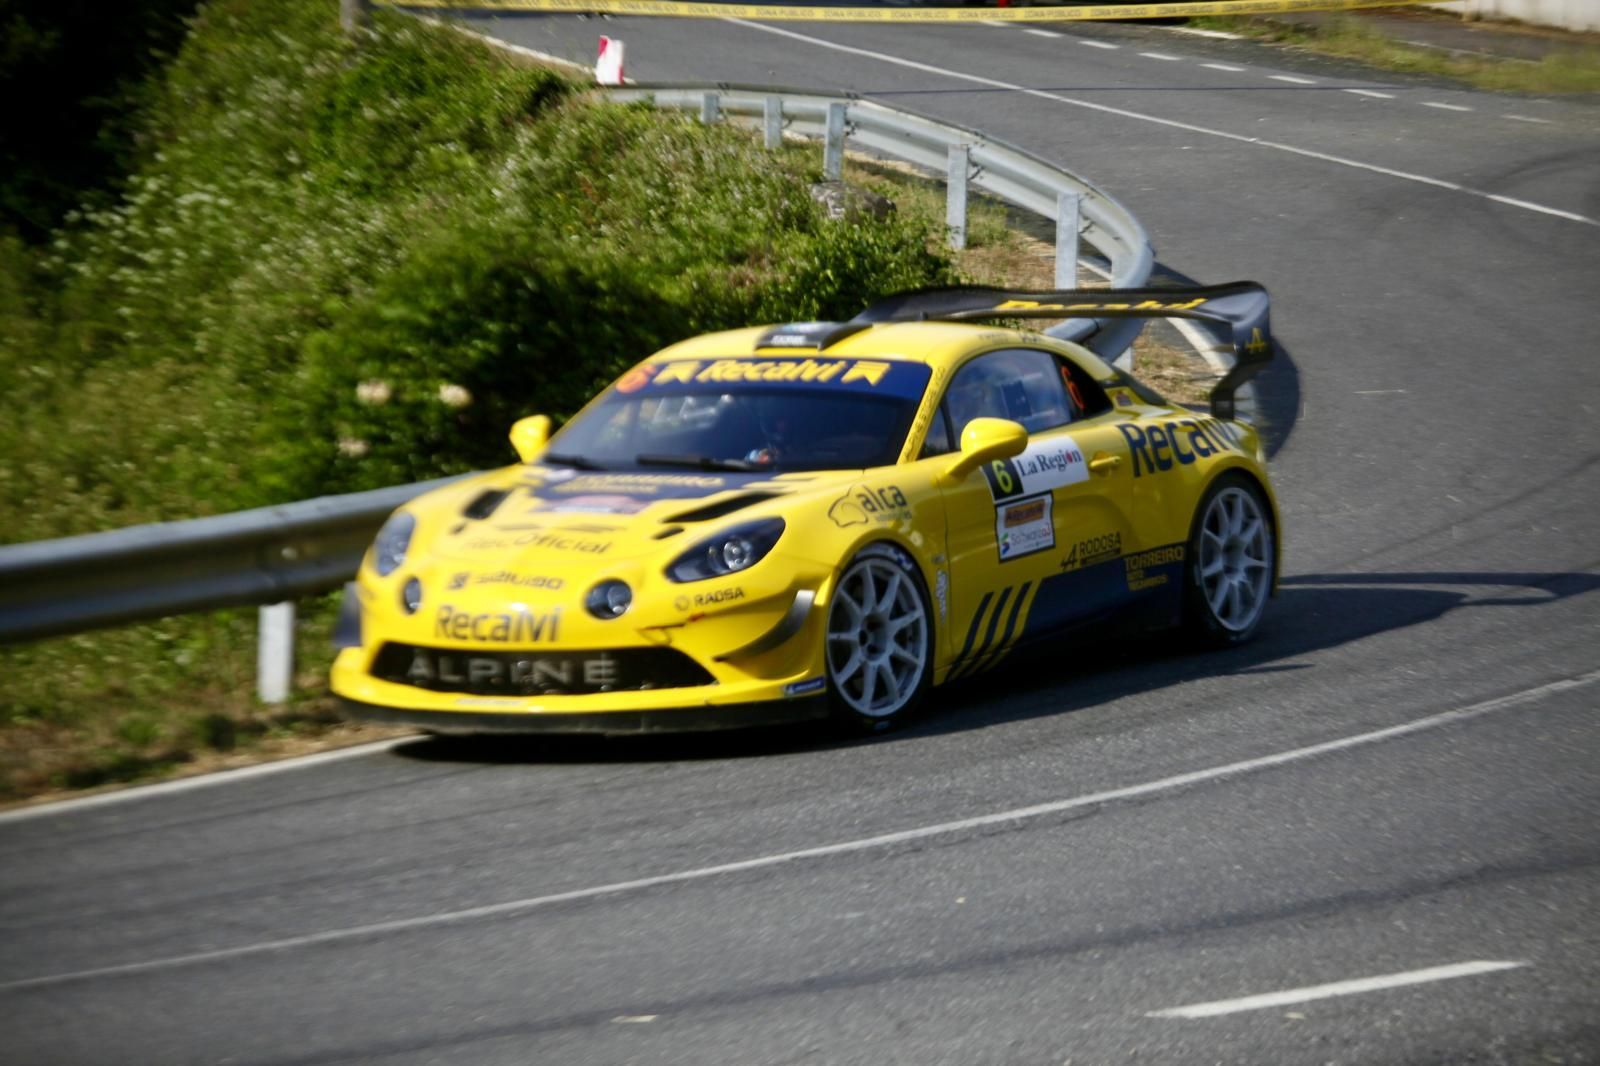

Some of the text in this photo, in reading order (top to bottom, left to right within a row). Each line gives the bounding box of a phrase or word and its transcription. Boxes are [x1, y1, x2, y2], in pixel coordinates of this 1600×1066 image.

[615, 359, 847, 393] 6 Recalvi
[992, 459, 1013, 493] 6
[1016, 459, 1038, 477] La
[856, 485, 907, 512] alca
[1079, 531, 1121, 555] RODOSA
[1125, 546, 1184, 571] TORREIRO
[693, 587, 745, 607] RADSA
[434, 604, 563, 643] Recalvi
[406, 654, 617, 685] ALPINE
